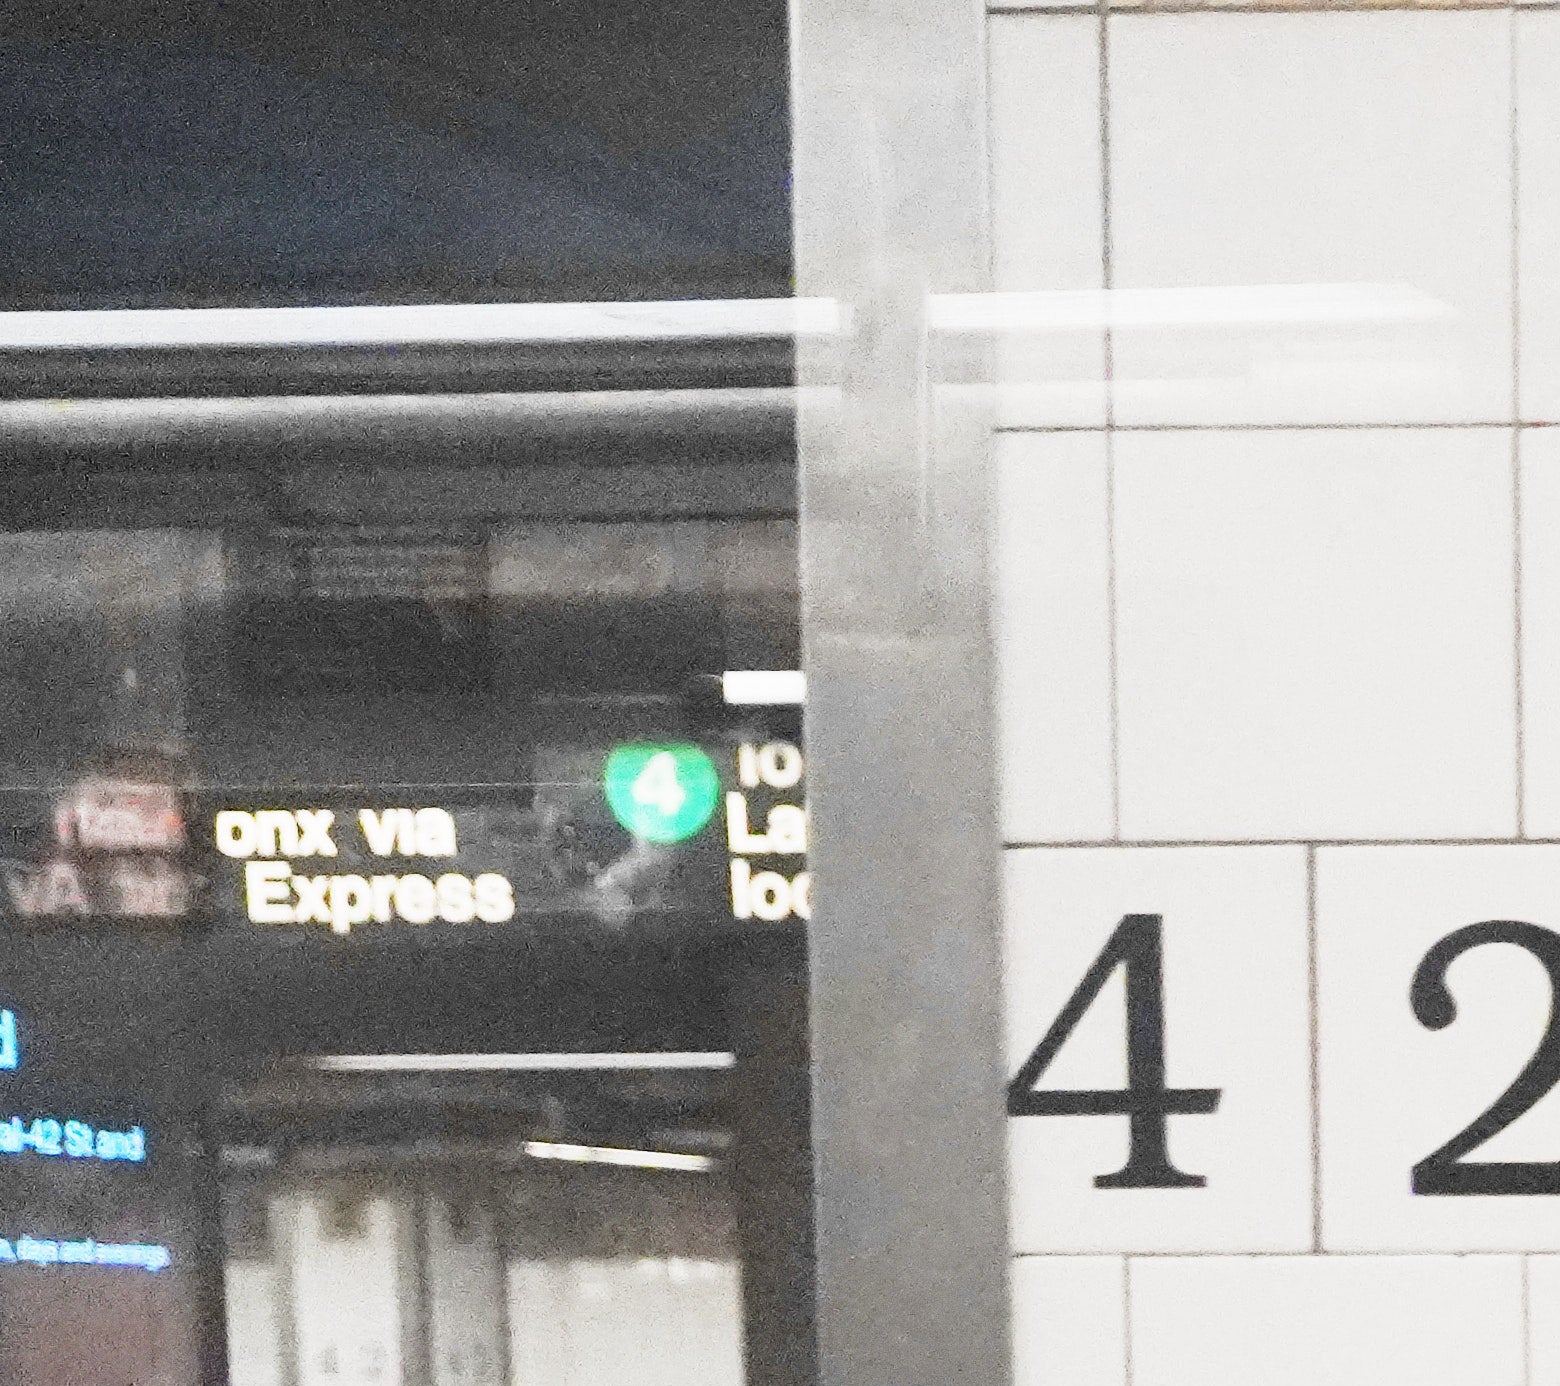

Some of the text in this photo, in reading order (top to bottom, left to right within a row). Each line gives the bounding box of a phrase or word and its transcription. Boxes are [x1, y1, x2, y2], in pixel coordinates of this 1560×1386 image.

[632, 752, 684, 816] 4
[361, 808, 457, 856] via
[246, 861, 514, 930] Express
